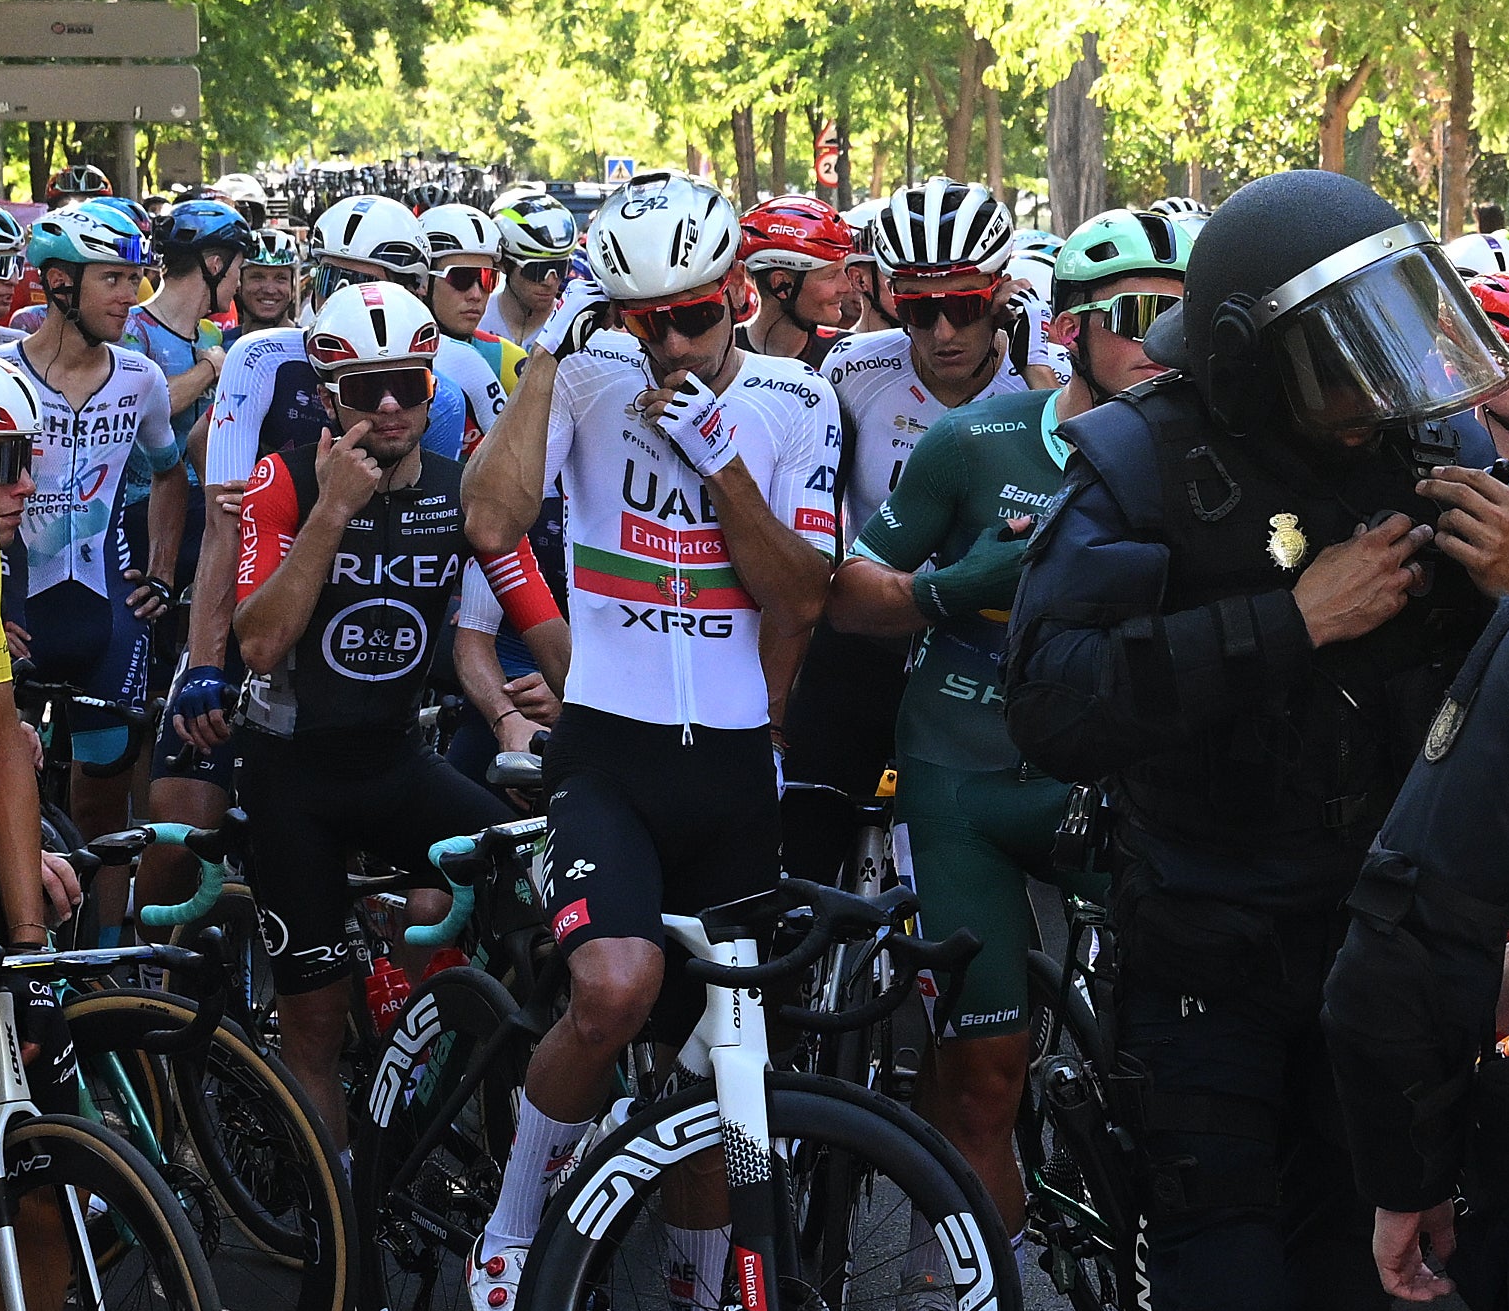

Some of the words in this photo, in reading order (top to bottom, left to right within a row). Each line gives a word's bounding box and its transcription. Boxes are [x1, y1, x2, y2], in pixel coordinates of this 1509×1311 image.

[620, 195, 669, 221] G42
[680, 213, 699, 269] MET
[767, 223, 809, 239] GIRO
[980, 212, 1007, 252] MET
[598, 230, 622, 277] MET
[244, 341, 286, 369] FANTINI
[579, 344, 642, 369] Analog
[845, 356, 903, 379] Analog
[759, 378, 821, 409] Analog
[27, 502, 89, 517] energies
[415, 508, 459, 521] LEGENDRE
[238, 502, 258, 585] ARKEA
[630, 524, 723, 556] Emirates
[618, 604, 734, 639] XRG
[339, 625, 364, 649] B
[368, 628, 392, 647] &
[393, 628, 416, 651] B
[121, 638, 143, 695] BUSINESS
[345, 652, 406, 664] HOTELS
[960, 1006, 1020, 1027] Santini
[4, 1022, 23, 1086] LOOK
[409, 1211, 448, 1242] SHIMANO
[742, 1254, 760, 1309] Emirates
